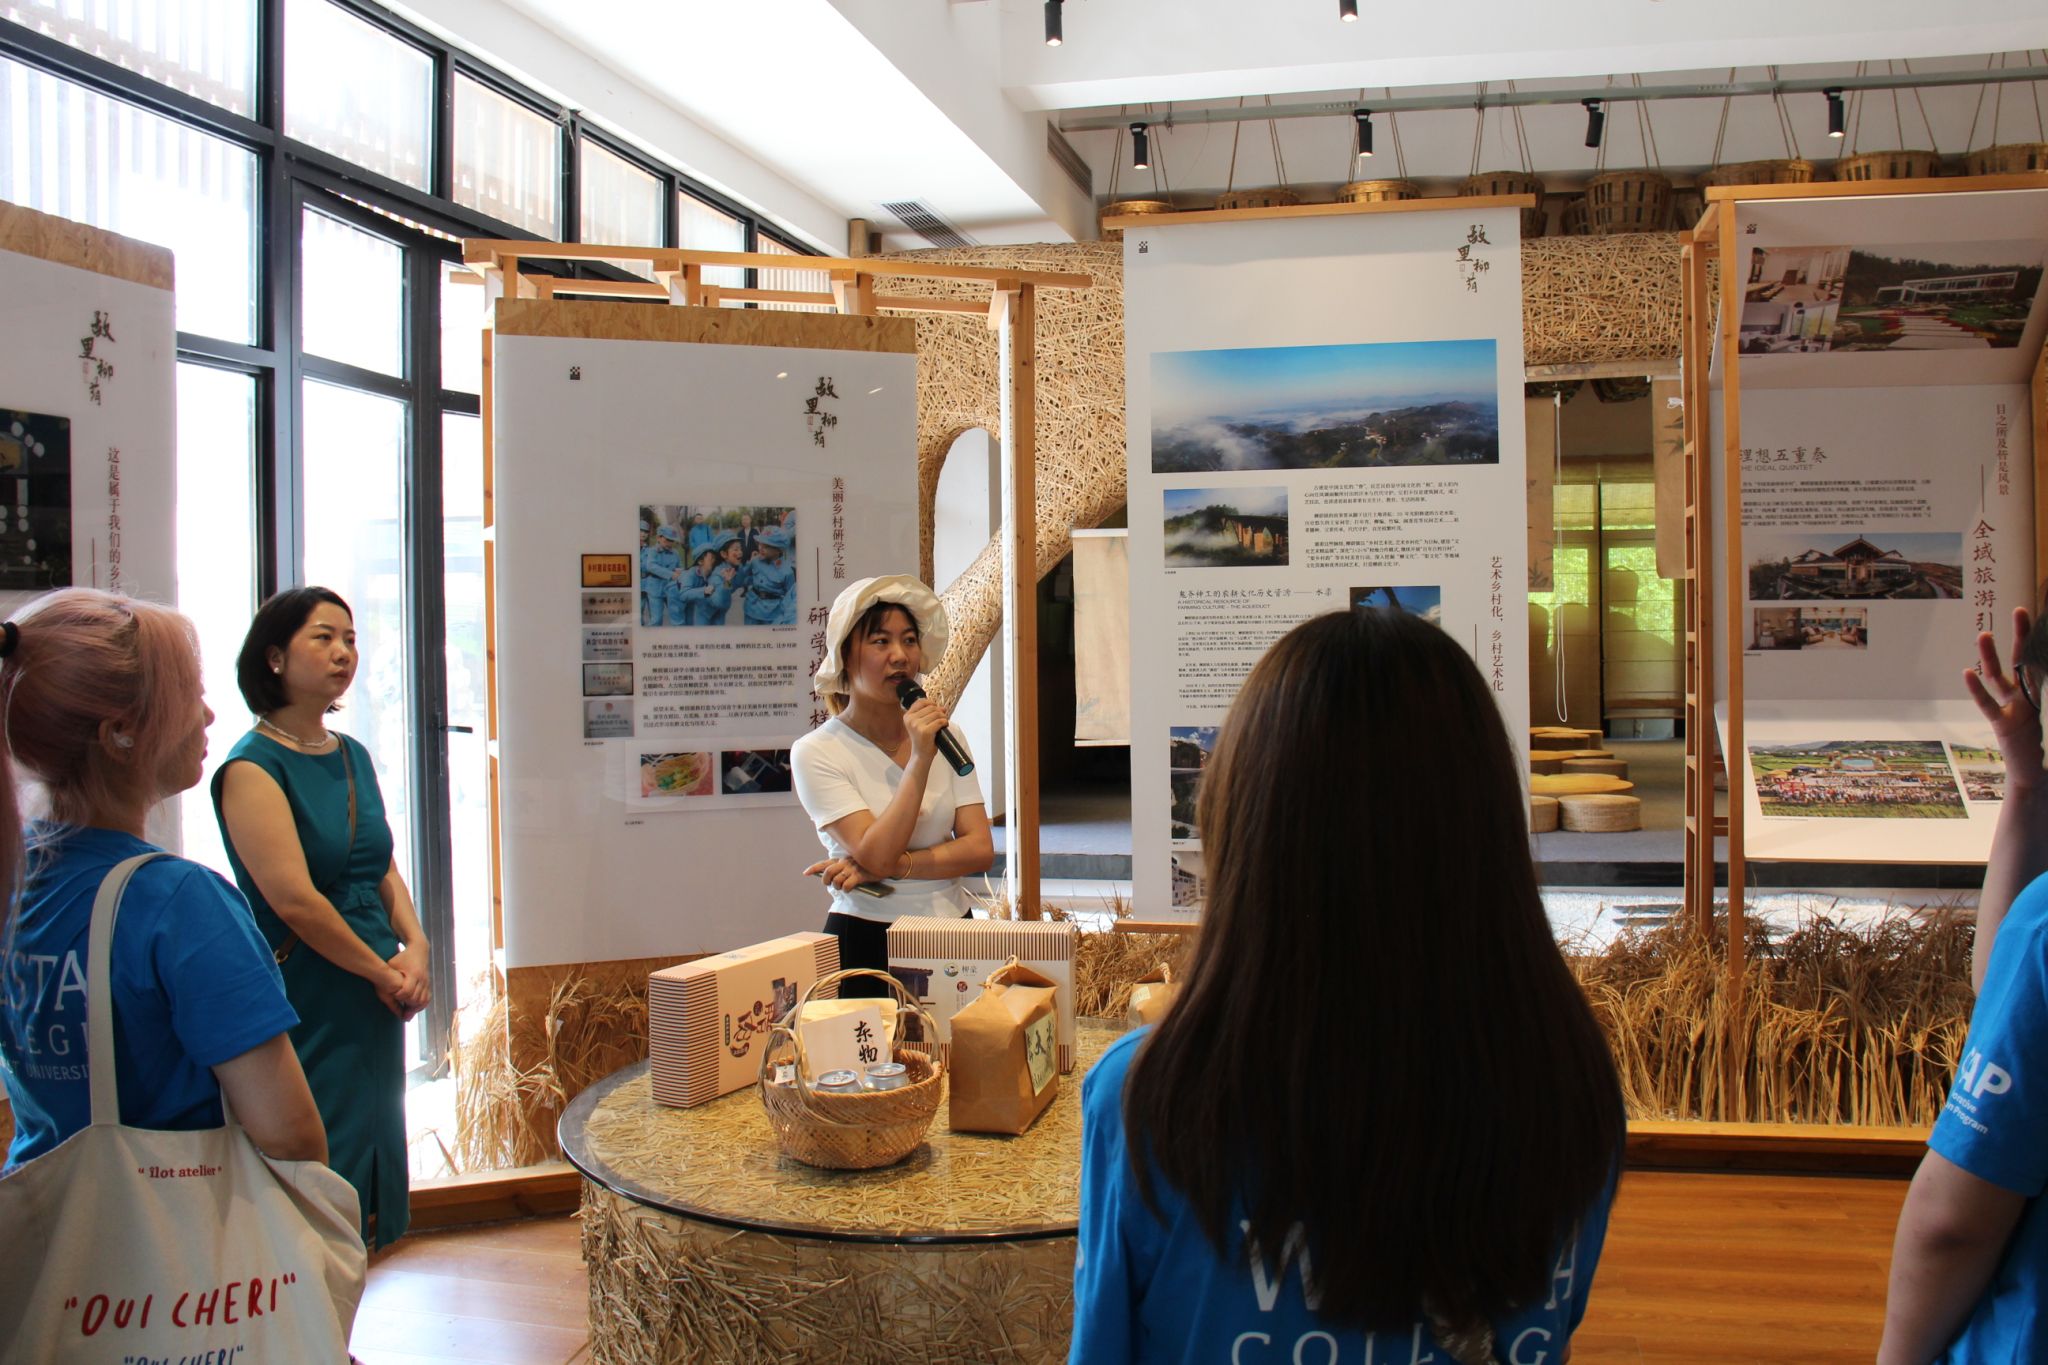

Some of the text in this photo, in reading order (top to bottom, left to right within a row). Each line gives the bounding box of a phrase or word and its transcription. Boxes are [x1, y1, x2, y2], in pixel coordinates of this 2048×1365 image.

[832, 477, 845, 579] 美丽乡村研学之旅
[1973, 519, 1997, 677] 全域旅游引
[26, 1064, 89, 1081] UNIVERSI
